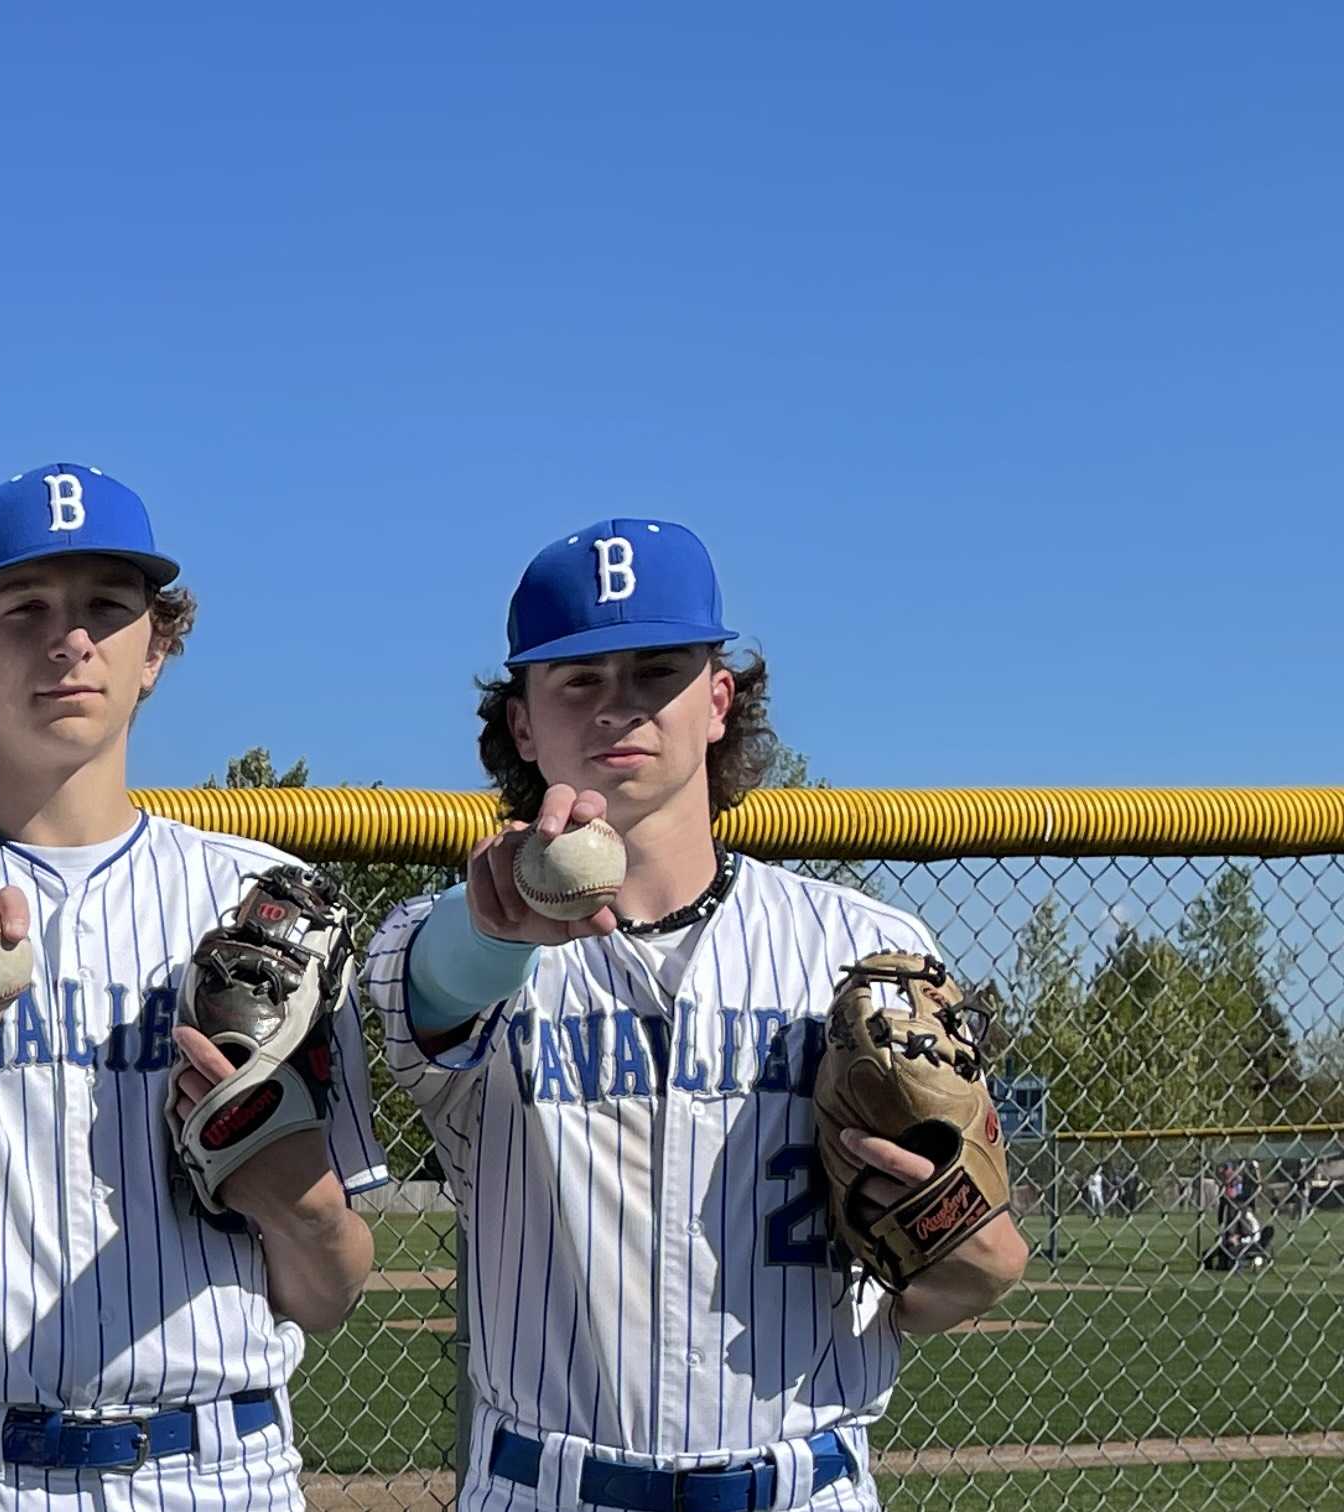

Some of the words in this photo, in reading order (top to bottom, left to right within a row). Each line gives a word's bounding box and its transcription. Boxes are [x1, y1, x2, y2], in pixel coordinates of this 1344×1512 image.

[43, 474, 86, 532] B
[593, 537, 636, 603] B
[916, 1183, 971, 1240] Rawlings
